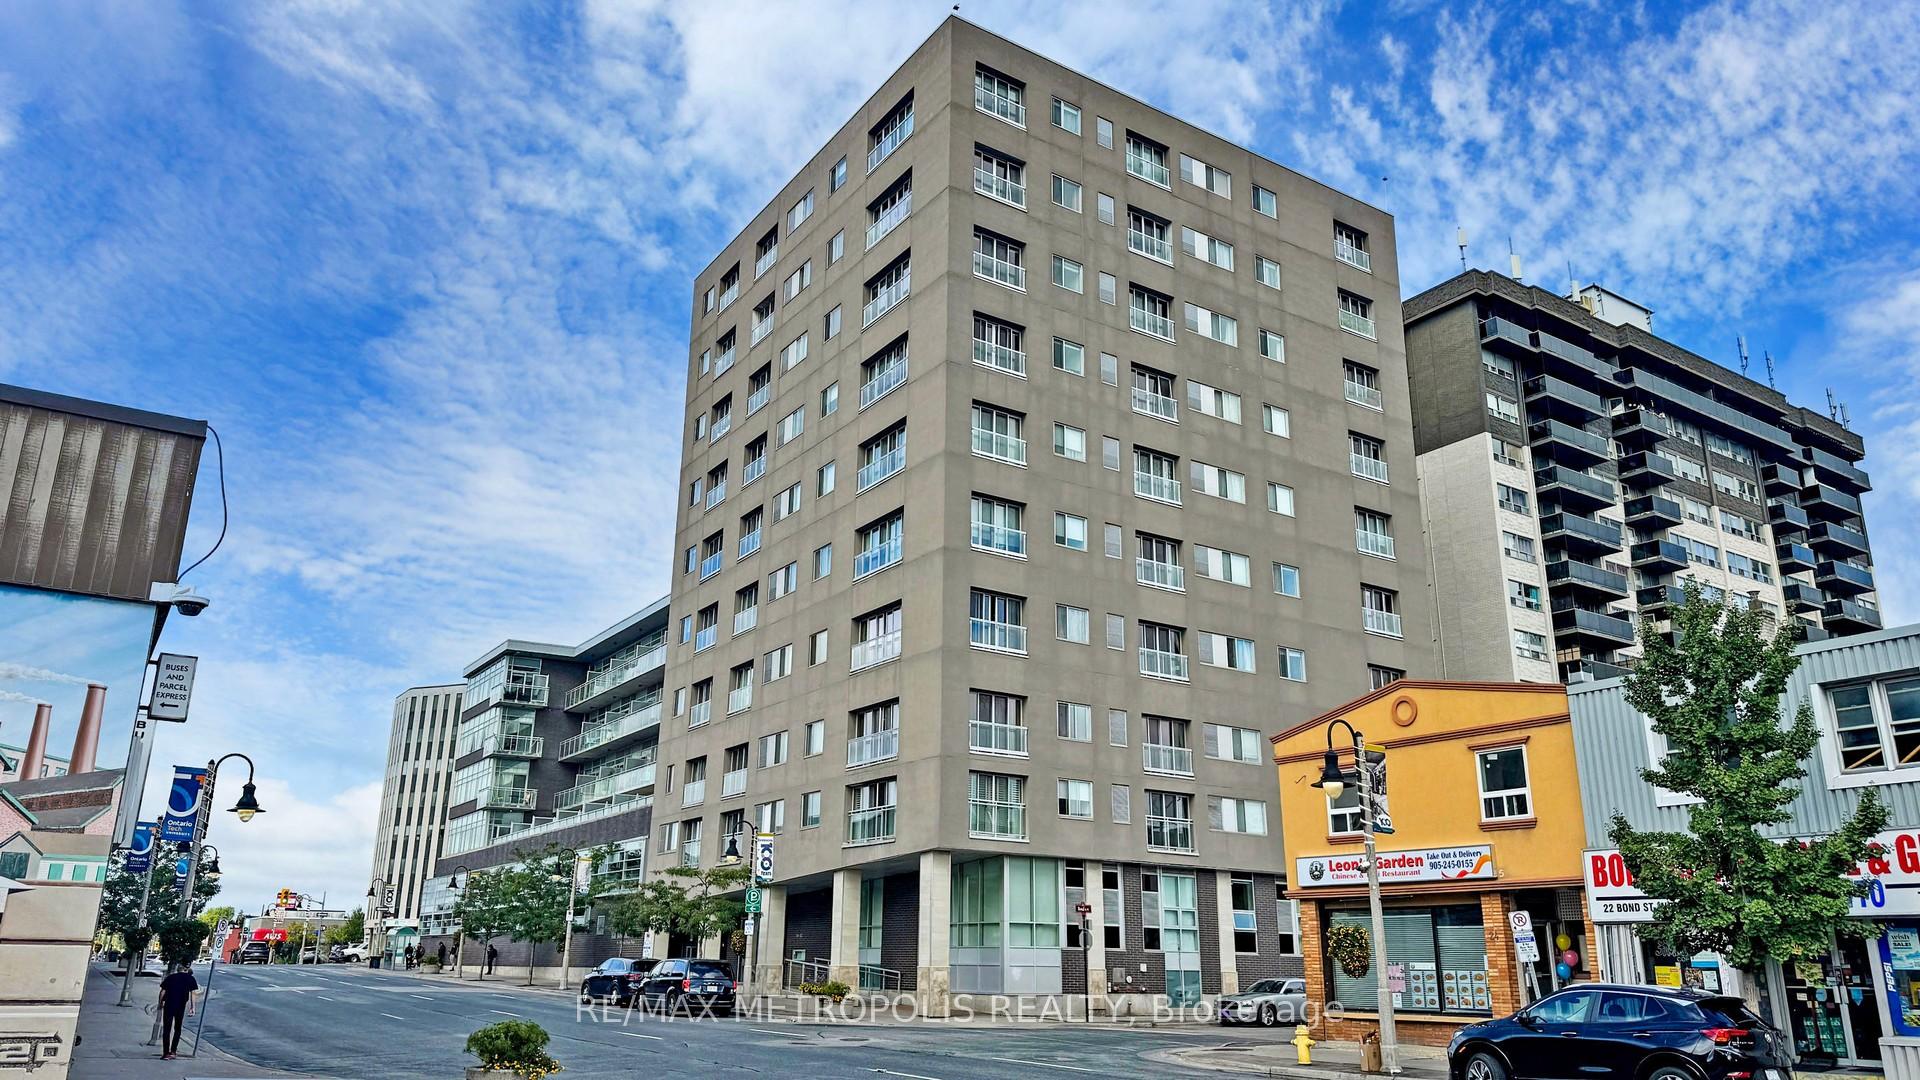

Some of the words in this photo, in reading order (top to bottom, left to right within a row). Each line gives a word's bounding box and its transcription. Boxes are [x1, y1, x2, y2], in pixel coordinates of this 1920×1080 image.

[165, 663, 188, 672] BUSES
[166, 673, 184, 681] AND
[159, 682, 188, 691] PARCEL
[156, 691, 187, 700] EXPRESS
[167, 819, 193, 827] Ontario
[1426, 852, 1440, 860] Take
[1441, 851, 1452, 859] Out
[1458, 849, 1482, 858] Delivery
[1328, 857, 1364, 872] Leon'
[1429, 859, 1474, 870] 905-245-0155
[1331, 872, 1357, 880] Chinese
[1382, 868, 1421, 877] Restaurant
[1603, 904, 1614, 913] 22
[1616, 902, 1640, 912] BOND
[1883, 962, 1897, 992] PEPSI
